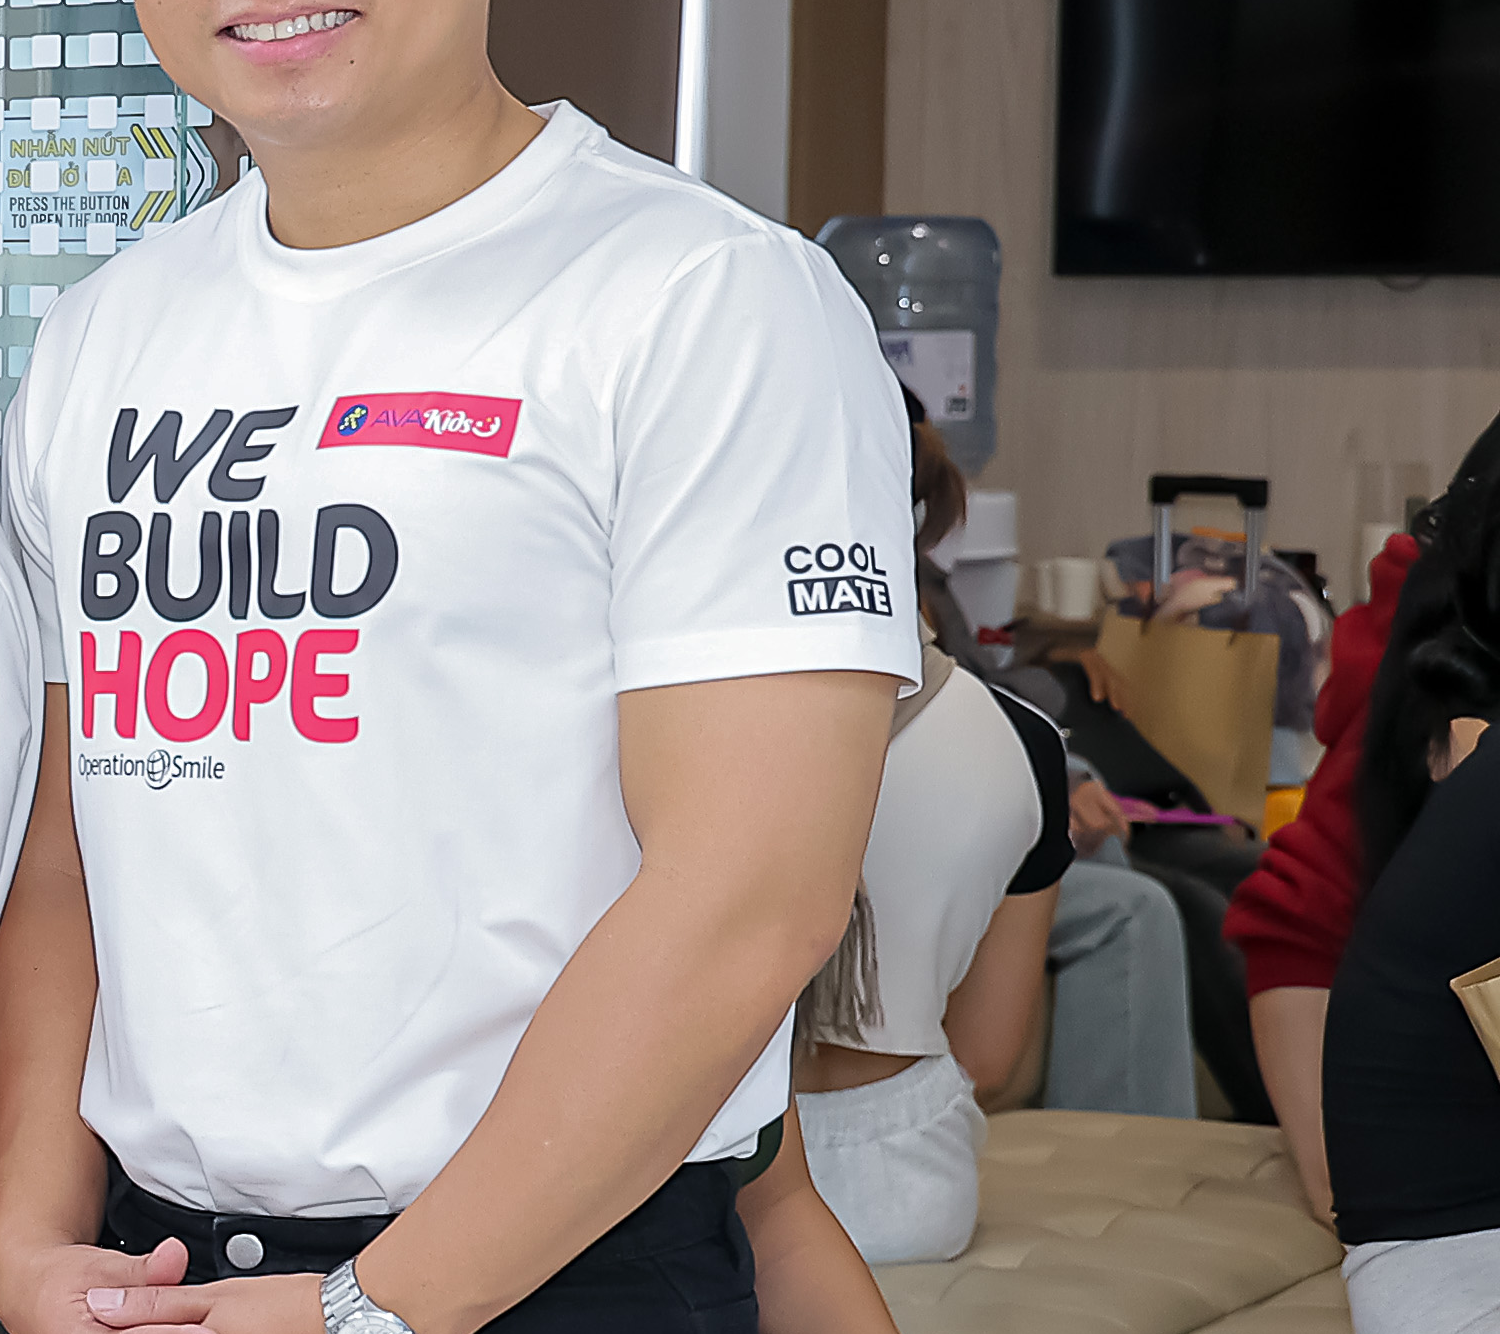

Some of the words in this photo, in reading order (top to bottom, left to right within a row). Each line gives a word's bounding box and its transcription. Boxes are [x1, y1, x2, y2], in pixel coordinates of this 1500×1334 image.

[83, 131, 131, 156] NÚT
[10, 196, 48, 211] PRESS
[52, 196, 76, 211] THE
[80, 195, 129, 211] BUTTON
[12, 213, 26, 228] TO
[31, 213, 62, 227] OPEN
[67, 213, 91, 227] THE
[95, 213, 128, 227] DOOR
[105, 405, 300, 504] WE
[79, 503, 399, 622] BUILD
[784, 542, 888, 576] COOL
[793, 580, 889, 613] MATE
[79, 628, 361, 744] HOPE
[78, 752, 145, 784] Operation
[171, 755, 225, 782] Smile
